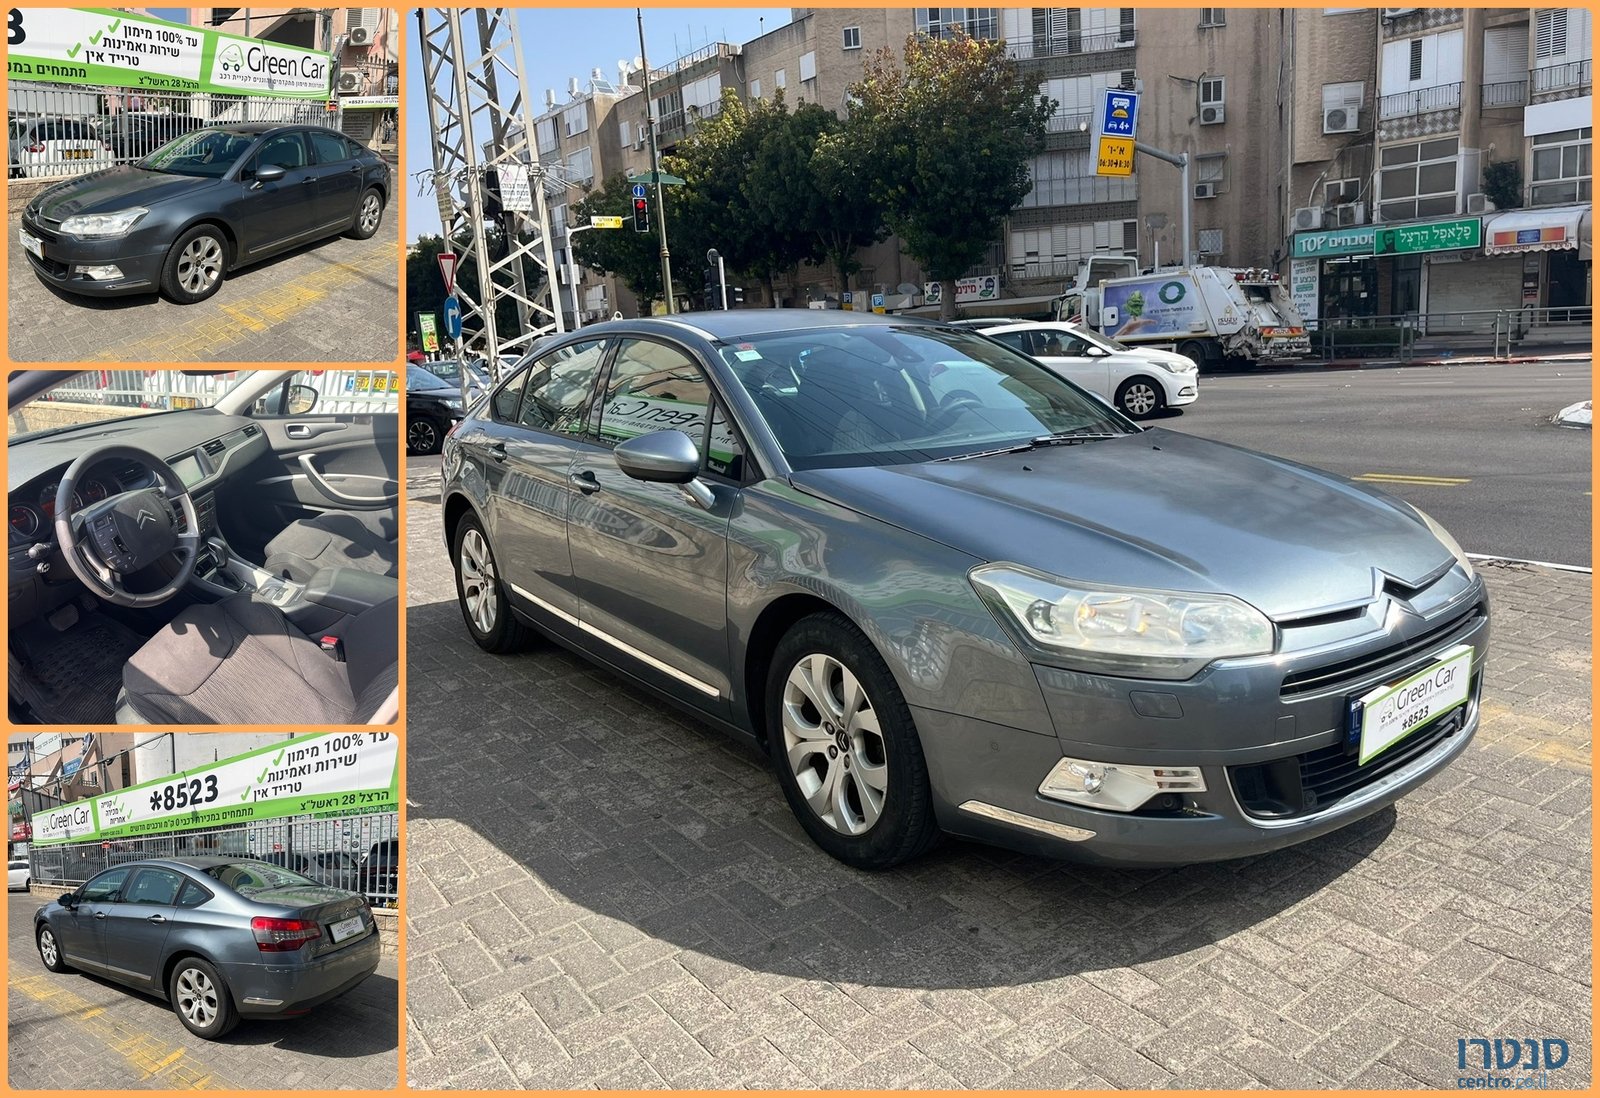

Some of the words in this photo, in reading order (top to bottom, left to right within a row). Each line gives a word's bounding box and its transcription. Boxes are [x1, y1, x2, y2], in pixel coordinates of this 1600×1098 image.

[124, 25, 152, 39] מימון
[156, 30, 183, 44] 100%
[103, 37, 147, 53] ואמינות
[186, 36, 198, 47] עד
[85, 50, 104, 64] אין
[150, 44, 180, 57] שירות
[108, 53, 139, 66] טרייד
[247, 47, 297, 76] Green
[301, 56, 325, 79] Car
[37, 65, 87, 78] מתמחים
[171, 78, 181, 87] 28
[182, 80, 199, 89] הרצל
[1300, 236, 1327, 252] TOP
[1397, 678, 1433, 710] Green
[1435, 666, 1457, 688] Car
[324, 733, 363, 754] 100%
[287, 746, 319, 766] מימון
[315, 753, 357, 773] שירות
[267, 763, 311, 783] ואמינות
[253, 788, 268, 802] אין
[272, 782, 302, 796] טרייד
[342, 794, 356, 805] 28
[359, 791, 389, 803] הרצל
[50, 813, 73, 829] Green
[74, 807, 89, 825] Car
[222, 808, 253, 820] מתמחים
